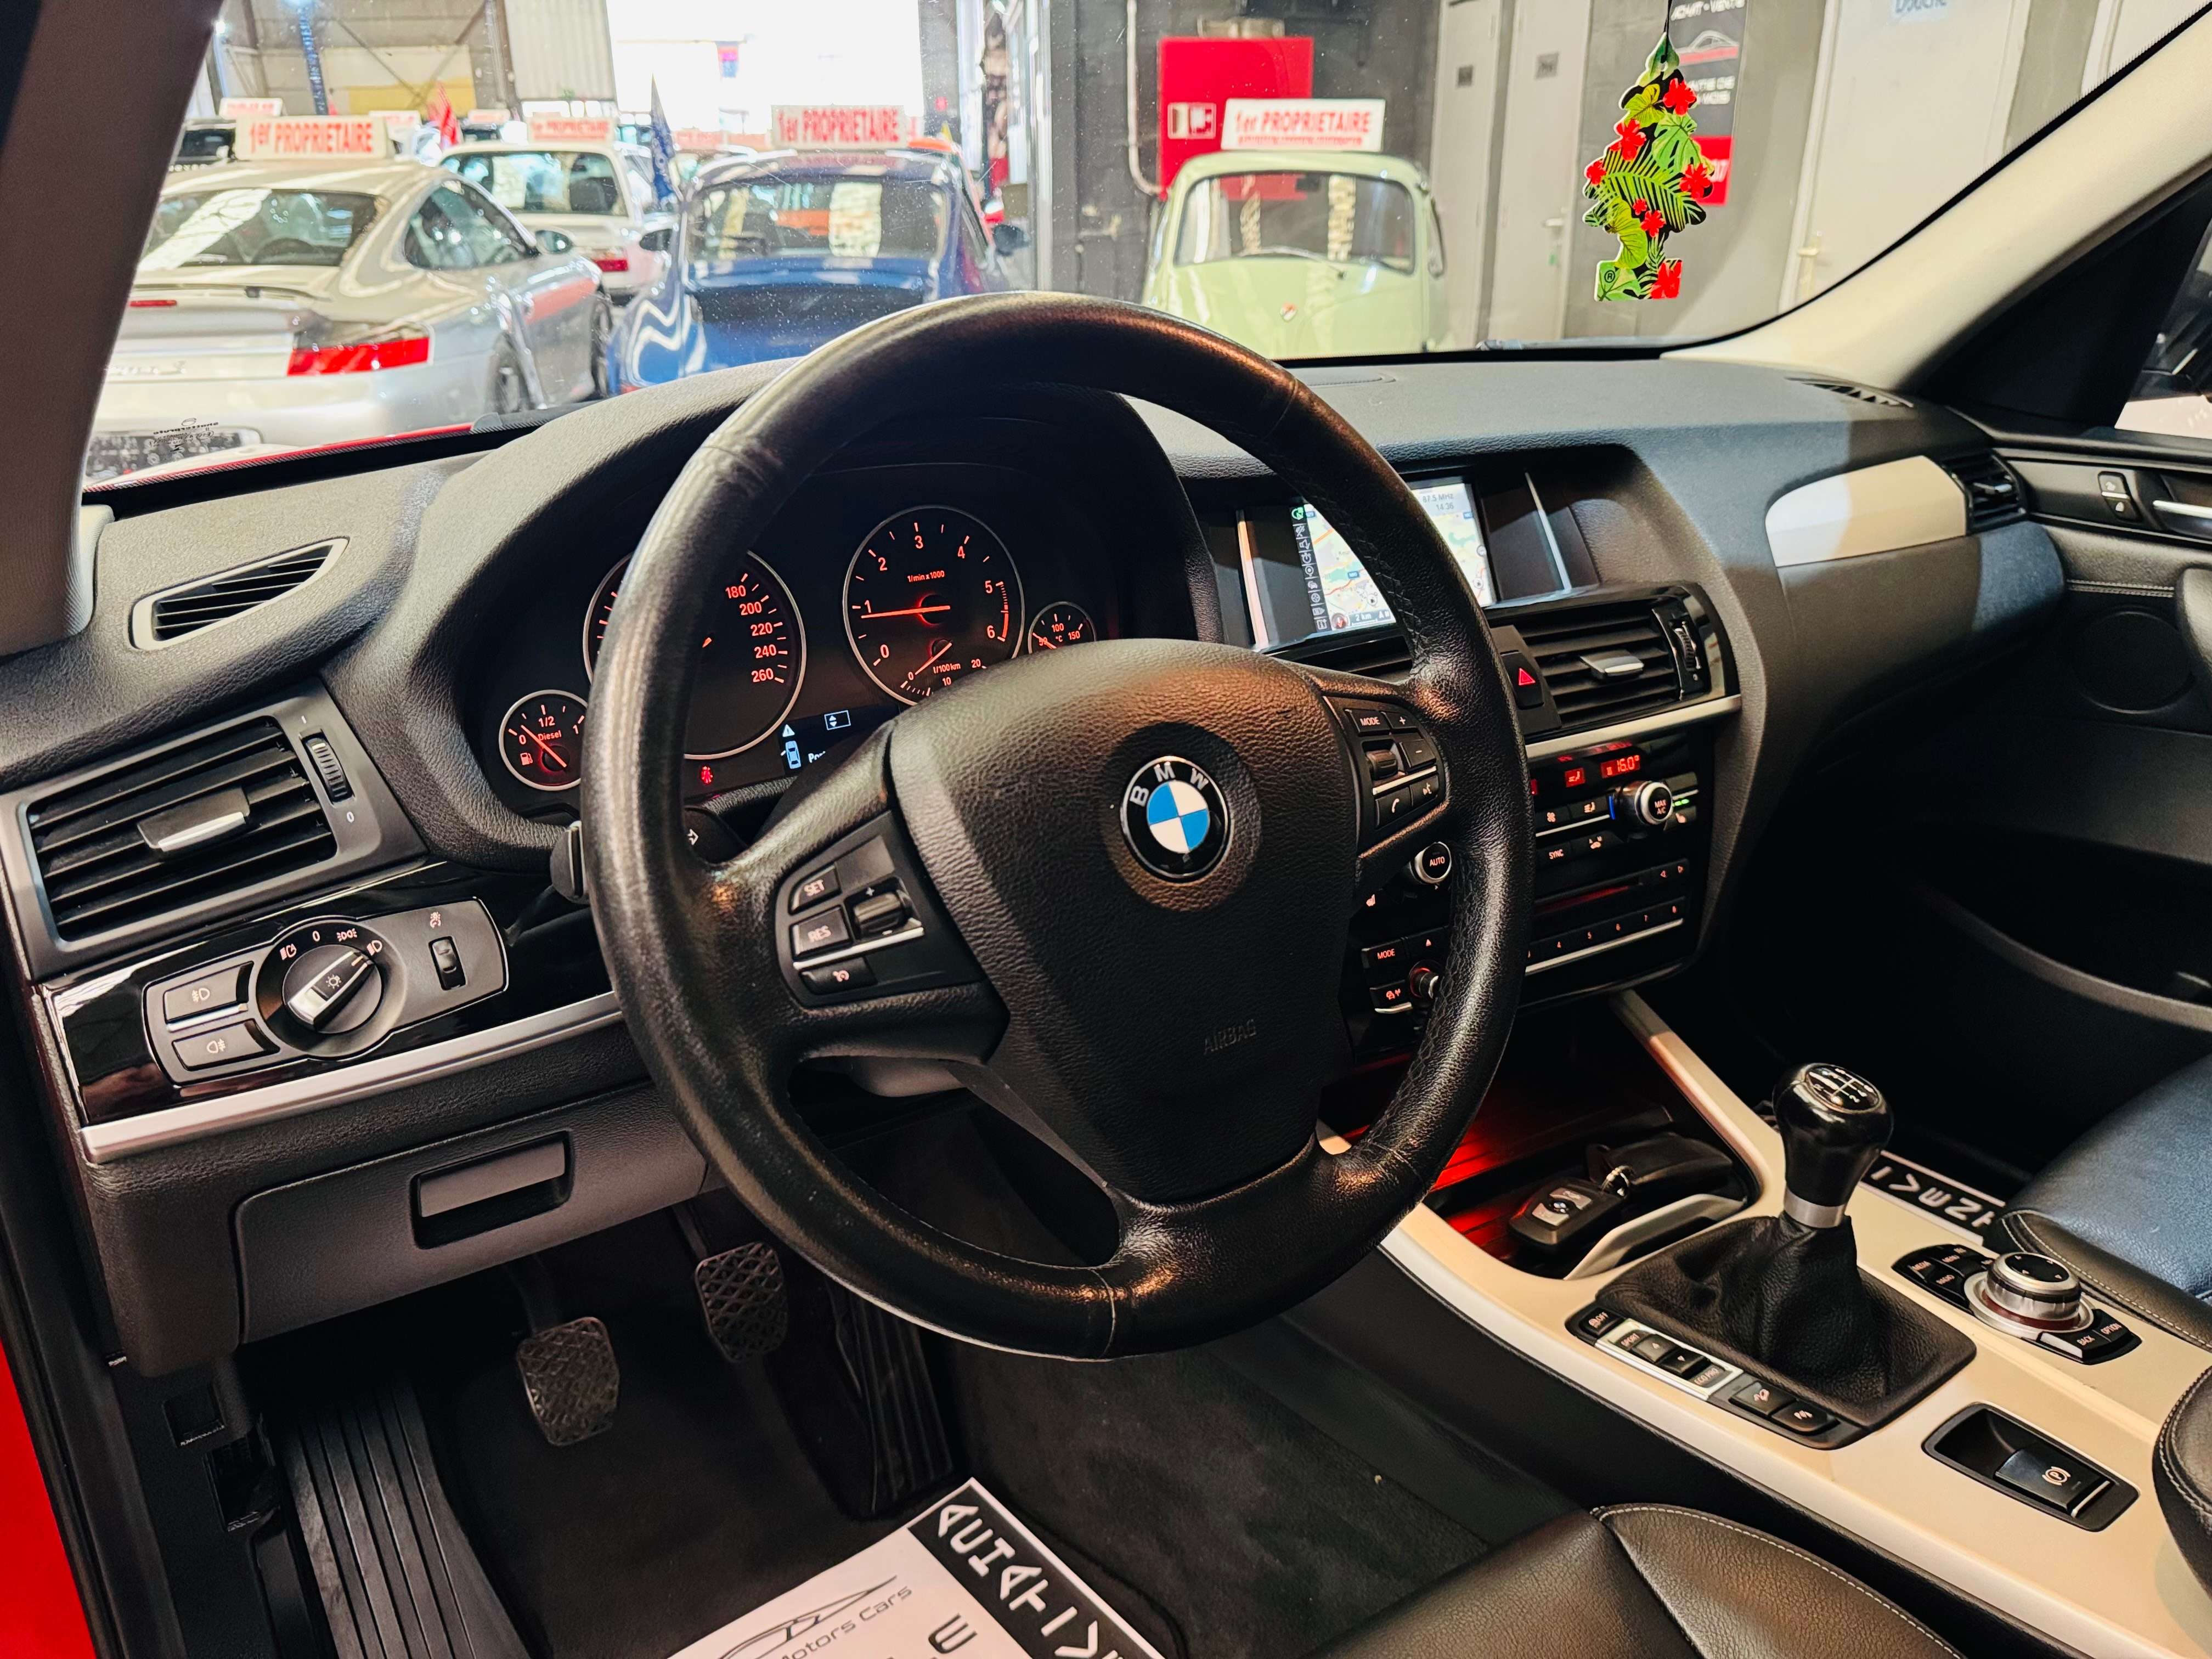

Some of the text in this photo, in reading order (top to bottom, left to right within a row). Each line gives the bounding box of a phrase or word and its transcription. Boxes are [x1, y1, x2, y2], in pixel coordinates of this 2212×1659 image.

[803, 109, 899, 142] PROPRIETAIRE
[1261, 111, 1370, 133] PROPRIETAIRE
[251, 122, 373, 154] 1er PROPRIETAIRE
[915, 536, 924, 549] 3
[957, 546, 966, 559] 4
[878, 557, 888, 571] 2
[725, 585, 746, 599] 180
[985, 580, 993, 594] 5
[740, 601, 762, 616] 200
[751, 622, 773, 636] 220
[987, 625, 996, 639] 6
[1051, 623, 1064, 633] 100
[1068, 630, 1081, 640] 150
[754, 644, 776, 658] 240
[880, 646, 889, 659] 0
[970, 658, 981, 668] 20
[751, 668, 774, 682] 260
[908, 672, 914, 680] 0
[942, 676, 952, 686] 10
[538, 716, 556, 727] 1/2
[1359, 716, 1381, 726] MODE
[519, 735, 527, 745] 0
[537, 730, 562, 741] Diesel
[1129, 761, 1209, 808] BMW
[1654, 799, 1667, 809] MAX
[1549, 849, 1564, 860] SYNC
[1429, 856, 1446, 867] AUTO
[804, 879, 825, 897] SET
[807, 925, 832, 943] RES
[1377, 948, 1396, 960] MODE
[2100, 1323, 2122, 1335] OPTION
[1621, 1333, 1640, 1347] SPORT
[2076, 1335, 2095, 1346] BACK
[859, 1586, 912, 1622] Cars
